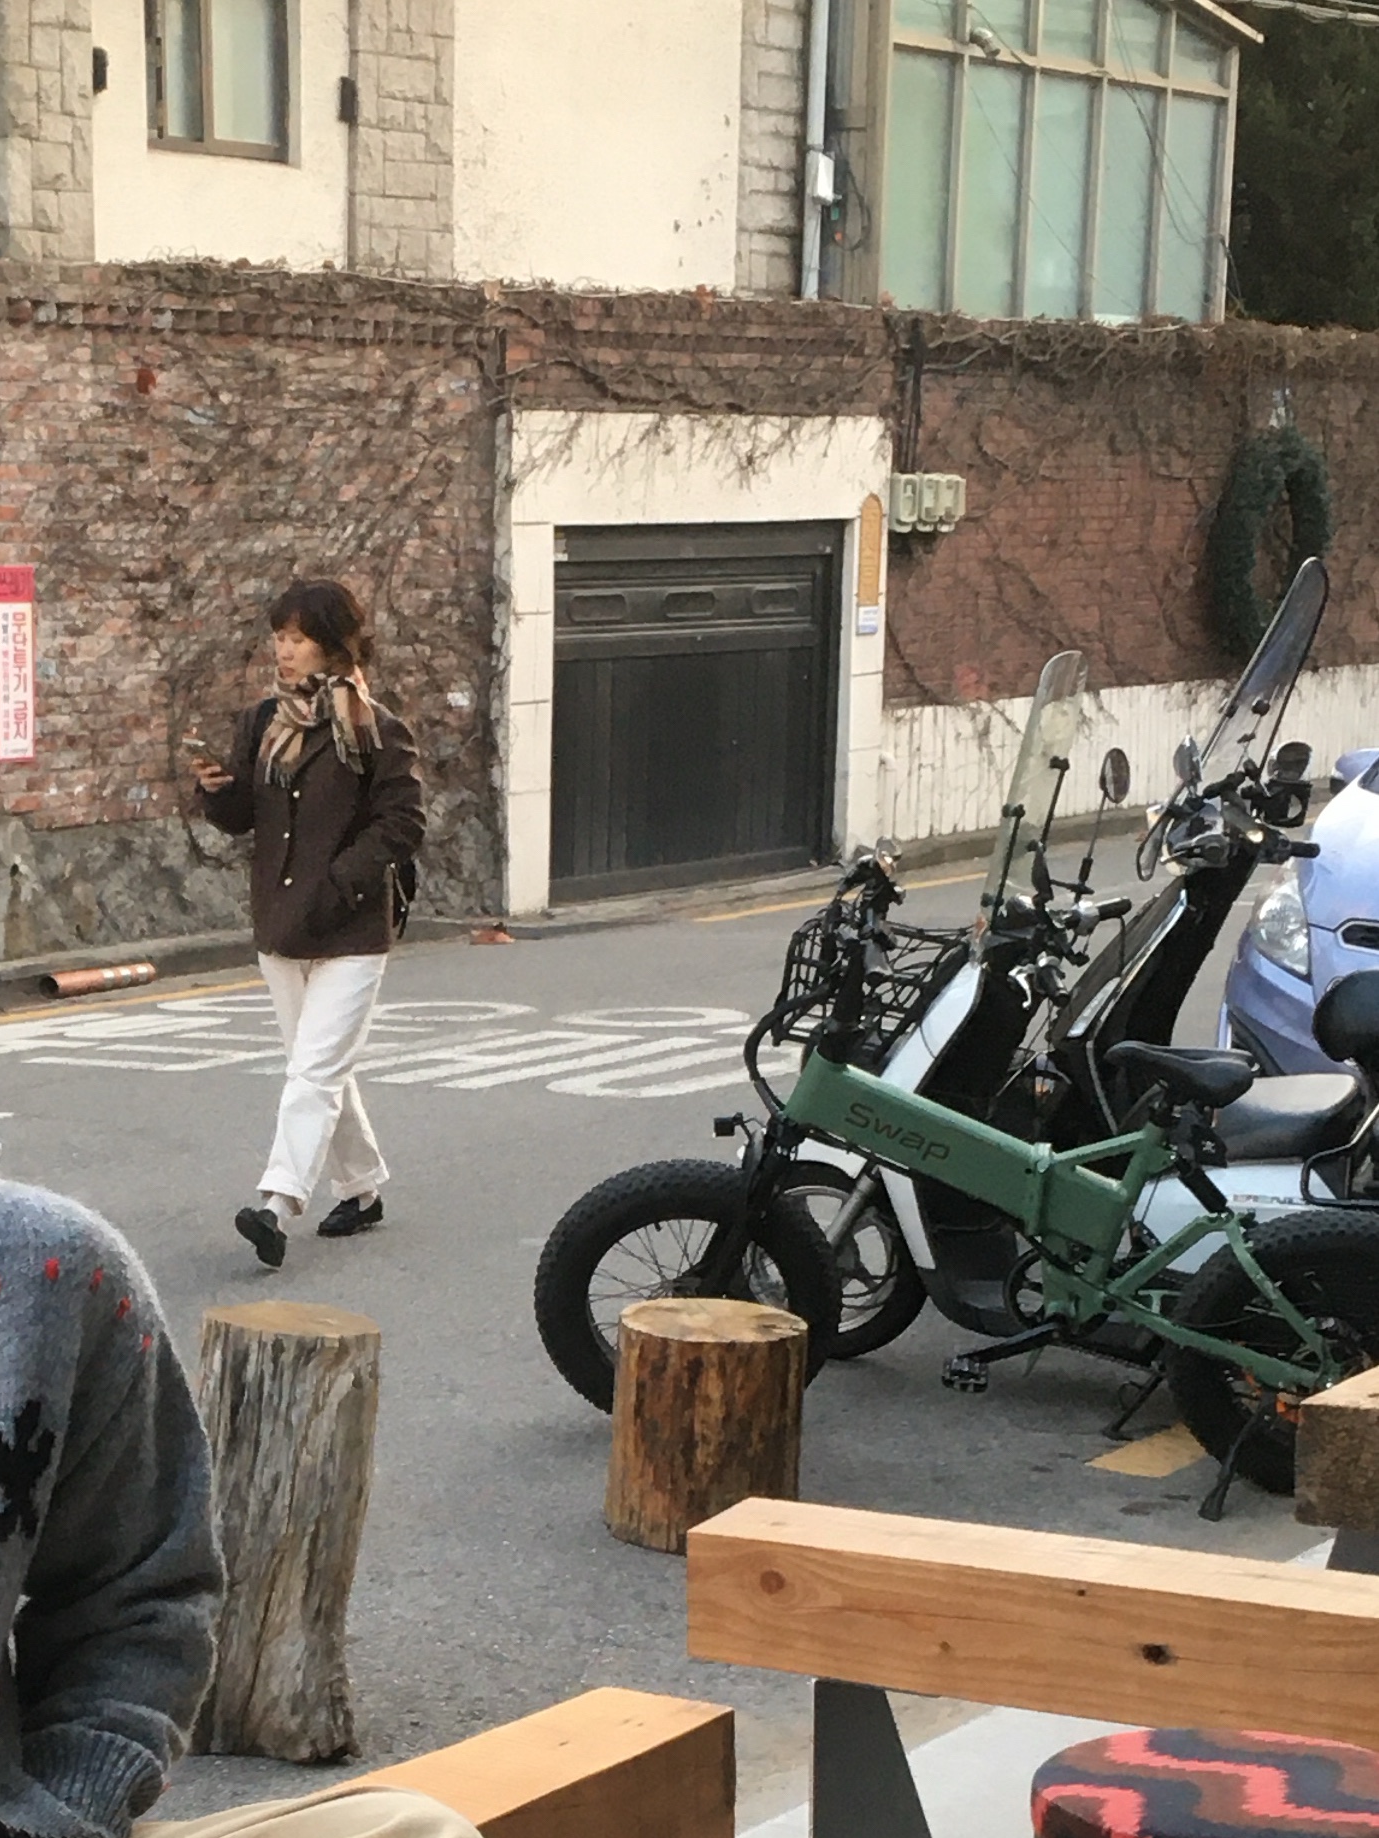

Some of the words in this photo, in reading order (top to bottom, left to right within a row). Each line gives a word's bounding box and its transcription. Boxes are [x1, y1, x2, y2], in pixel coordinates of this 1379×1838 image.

[12, 611, 27, 693] 무단투기
[13, 700, 28, 740] 금지
[845, 1102, 950, 1161] Swap
